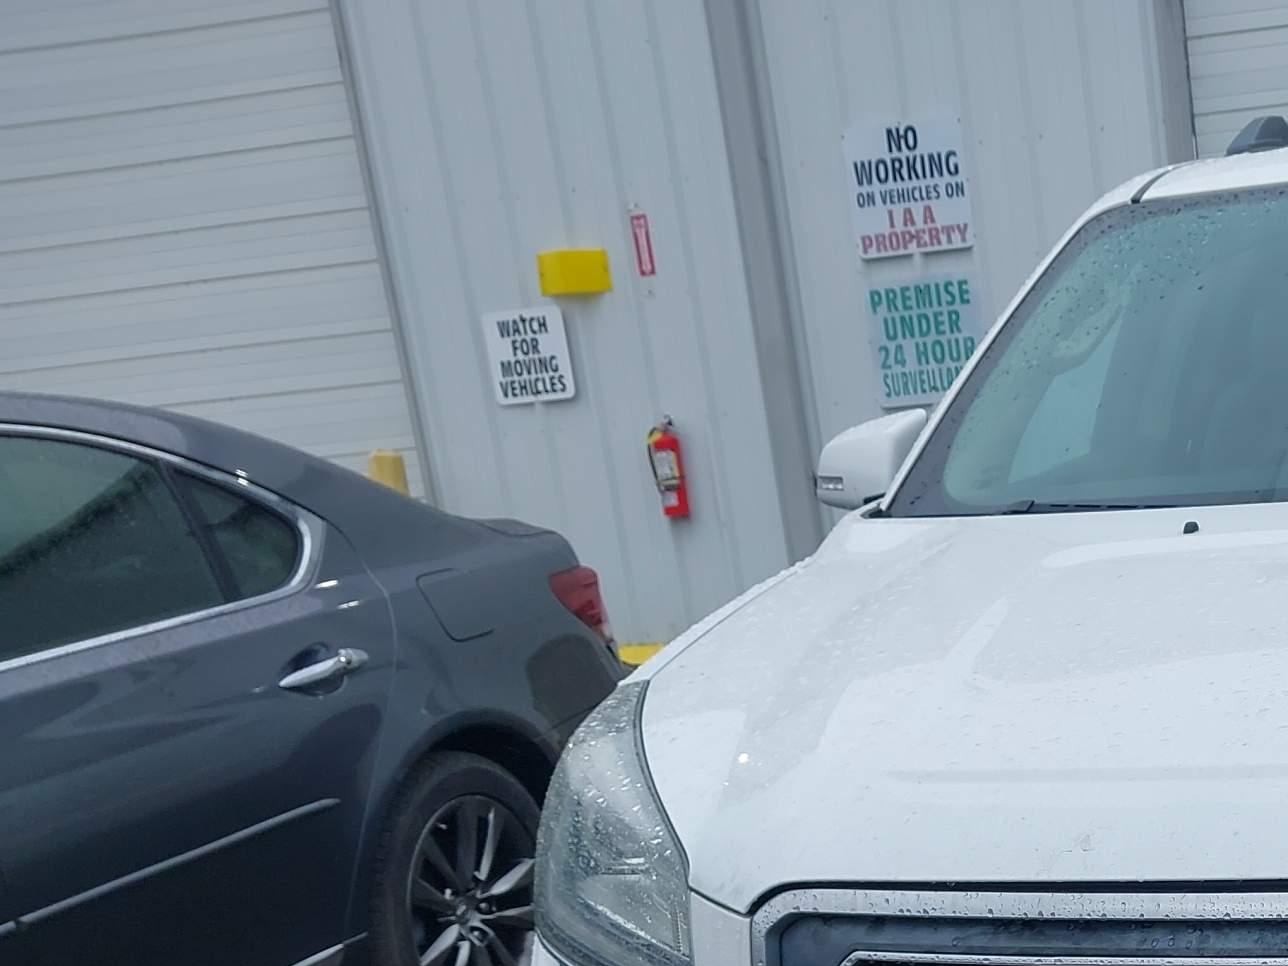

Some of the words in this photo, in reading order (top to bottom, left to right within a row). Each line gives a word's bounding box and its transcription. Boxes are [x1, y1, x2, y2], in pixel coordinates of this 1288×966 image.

[886, 125, 918, 153] NO
[853, 150, 960, 187] WORKING
[856, 191, 876, 208] ON
[879, 183, 941, 205] VEHICLES
[944, 181, 965, 198] ON
[861, 223, 968, 254] PROPERTY
[869, 279, 970, 315] PREMISE
[496, 315, 549, 338] WATCH
[883, 309, 962, 341] UNDER
[511, 337, 540, 357] FOR
[878, 344, 906, 370] 24
[500, 355, 559, 378] MOVING
[499, 374, 567, 399] VEHICLES
